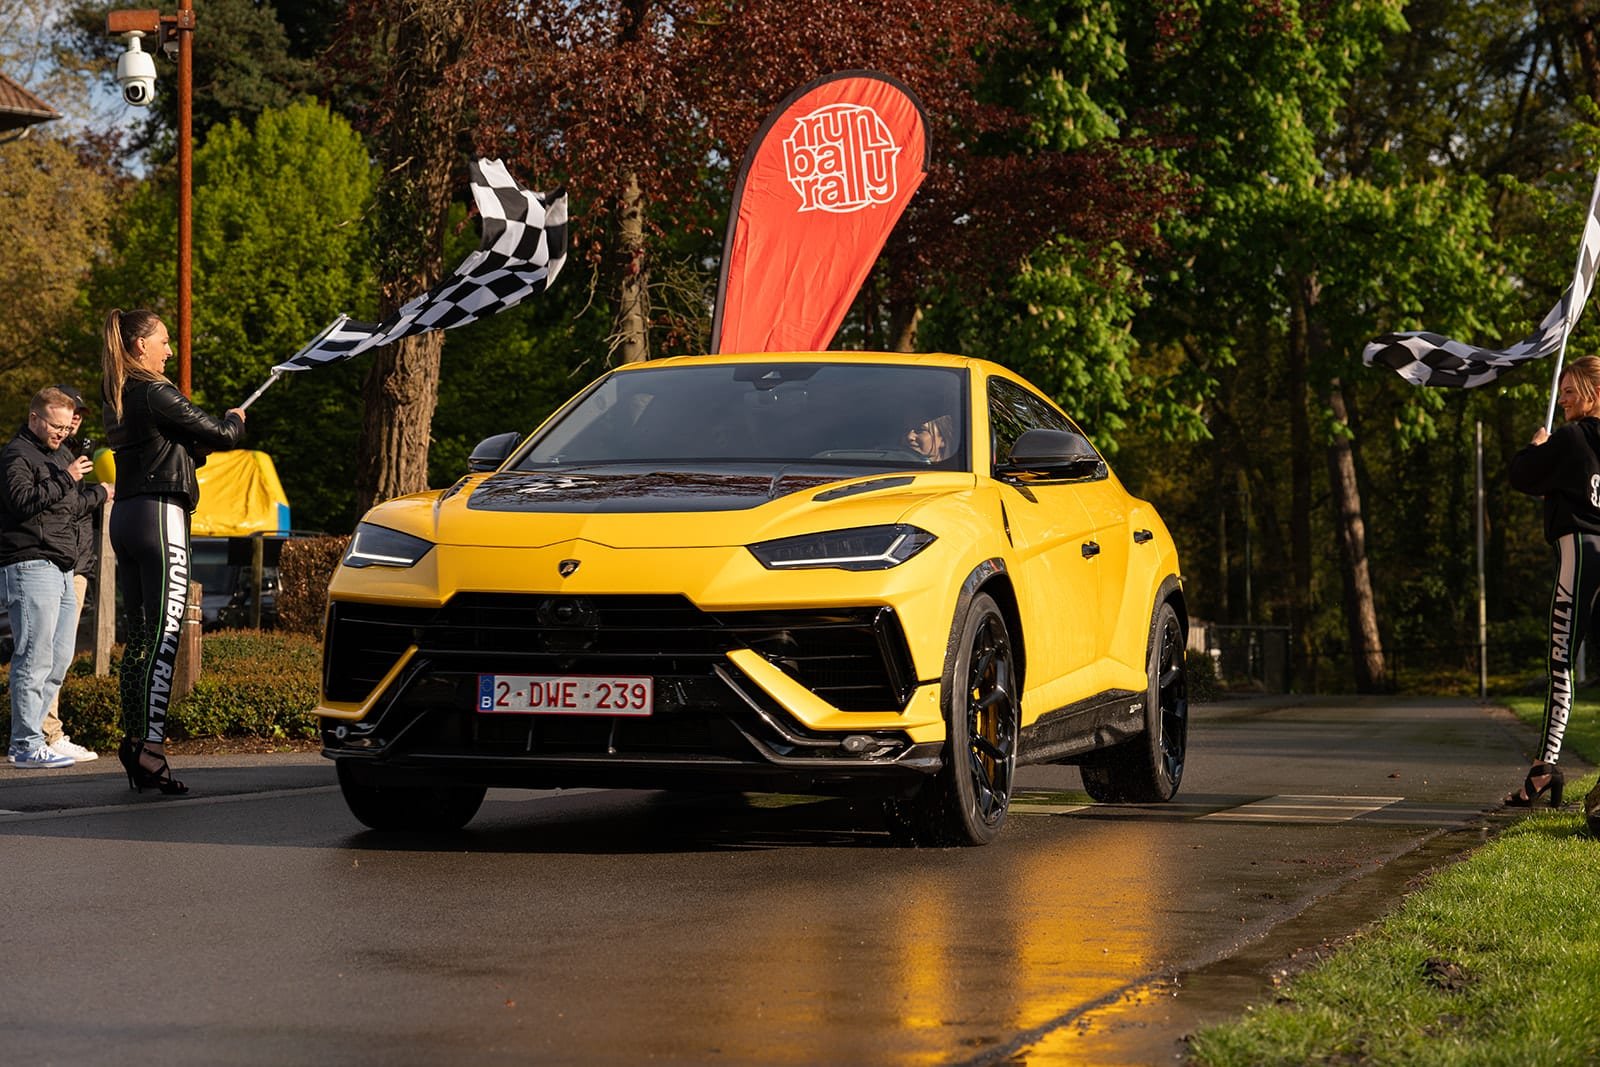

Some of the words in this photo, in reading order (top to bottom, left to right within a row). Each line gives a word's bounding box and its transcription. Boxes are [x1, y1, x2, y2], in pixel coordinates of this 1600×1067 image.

[795, 106, 890, 149] run
[160, 545, 188, 655] RUNBALL
[1551, 585, 1573, 663] RALLY
[149, 659, 173, 738] RALLY
[481, 696, 492, 708] B
[1543, 667, 1572, 765] RUNBALL
